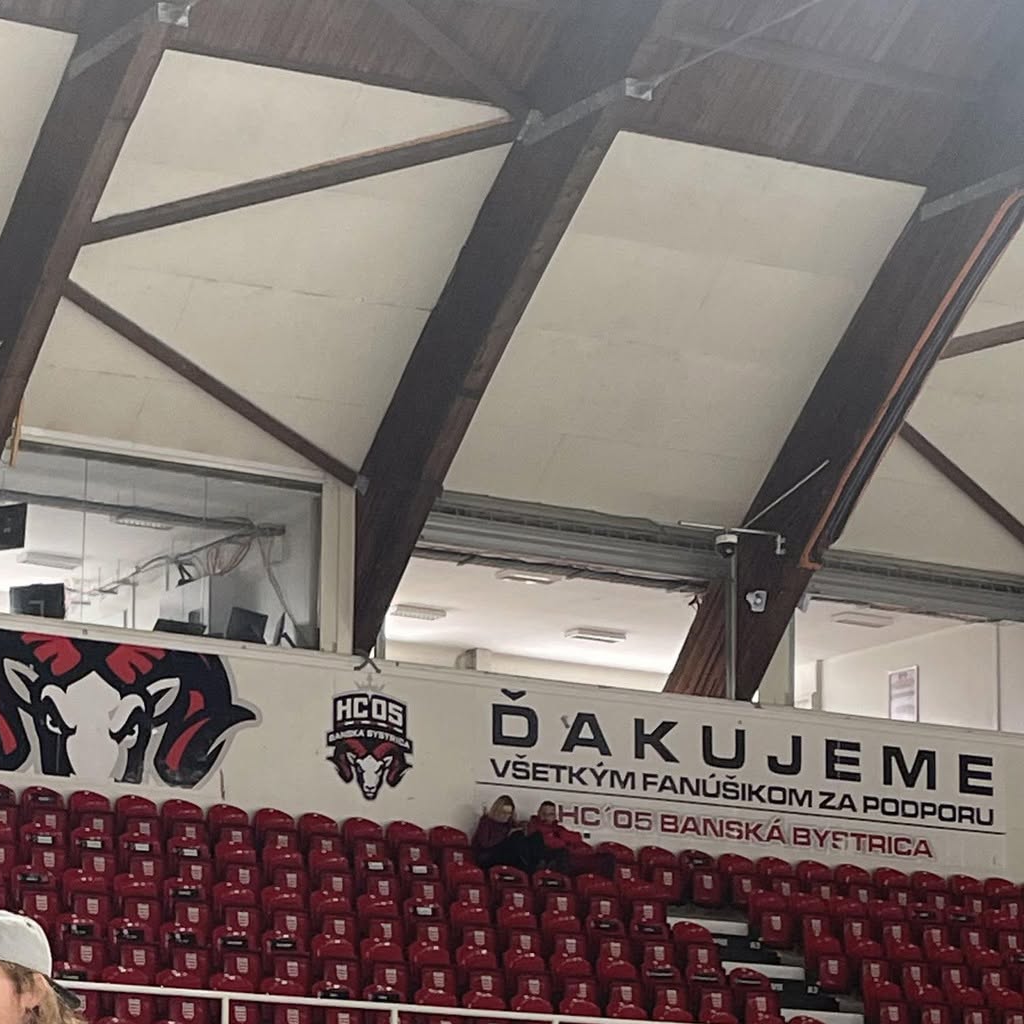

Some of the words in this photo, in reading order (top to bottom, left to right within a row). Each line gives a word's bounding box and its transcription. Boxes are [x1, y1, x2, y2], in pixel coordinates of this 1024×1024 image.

[492, 688, 994, 797] ĎAKUJEME
[490, 754, 636, 790] VŠETKÝM
[643, 773, 813, 807] FANÚŠIKOM
[819, 791, 857, 812] ZA
[863, 796, 994, 826] PODPORU
[661, 814, 786, 845] BANSKÁ
[793, 827, 933, 858] BYSTRICA
